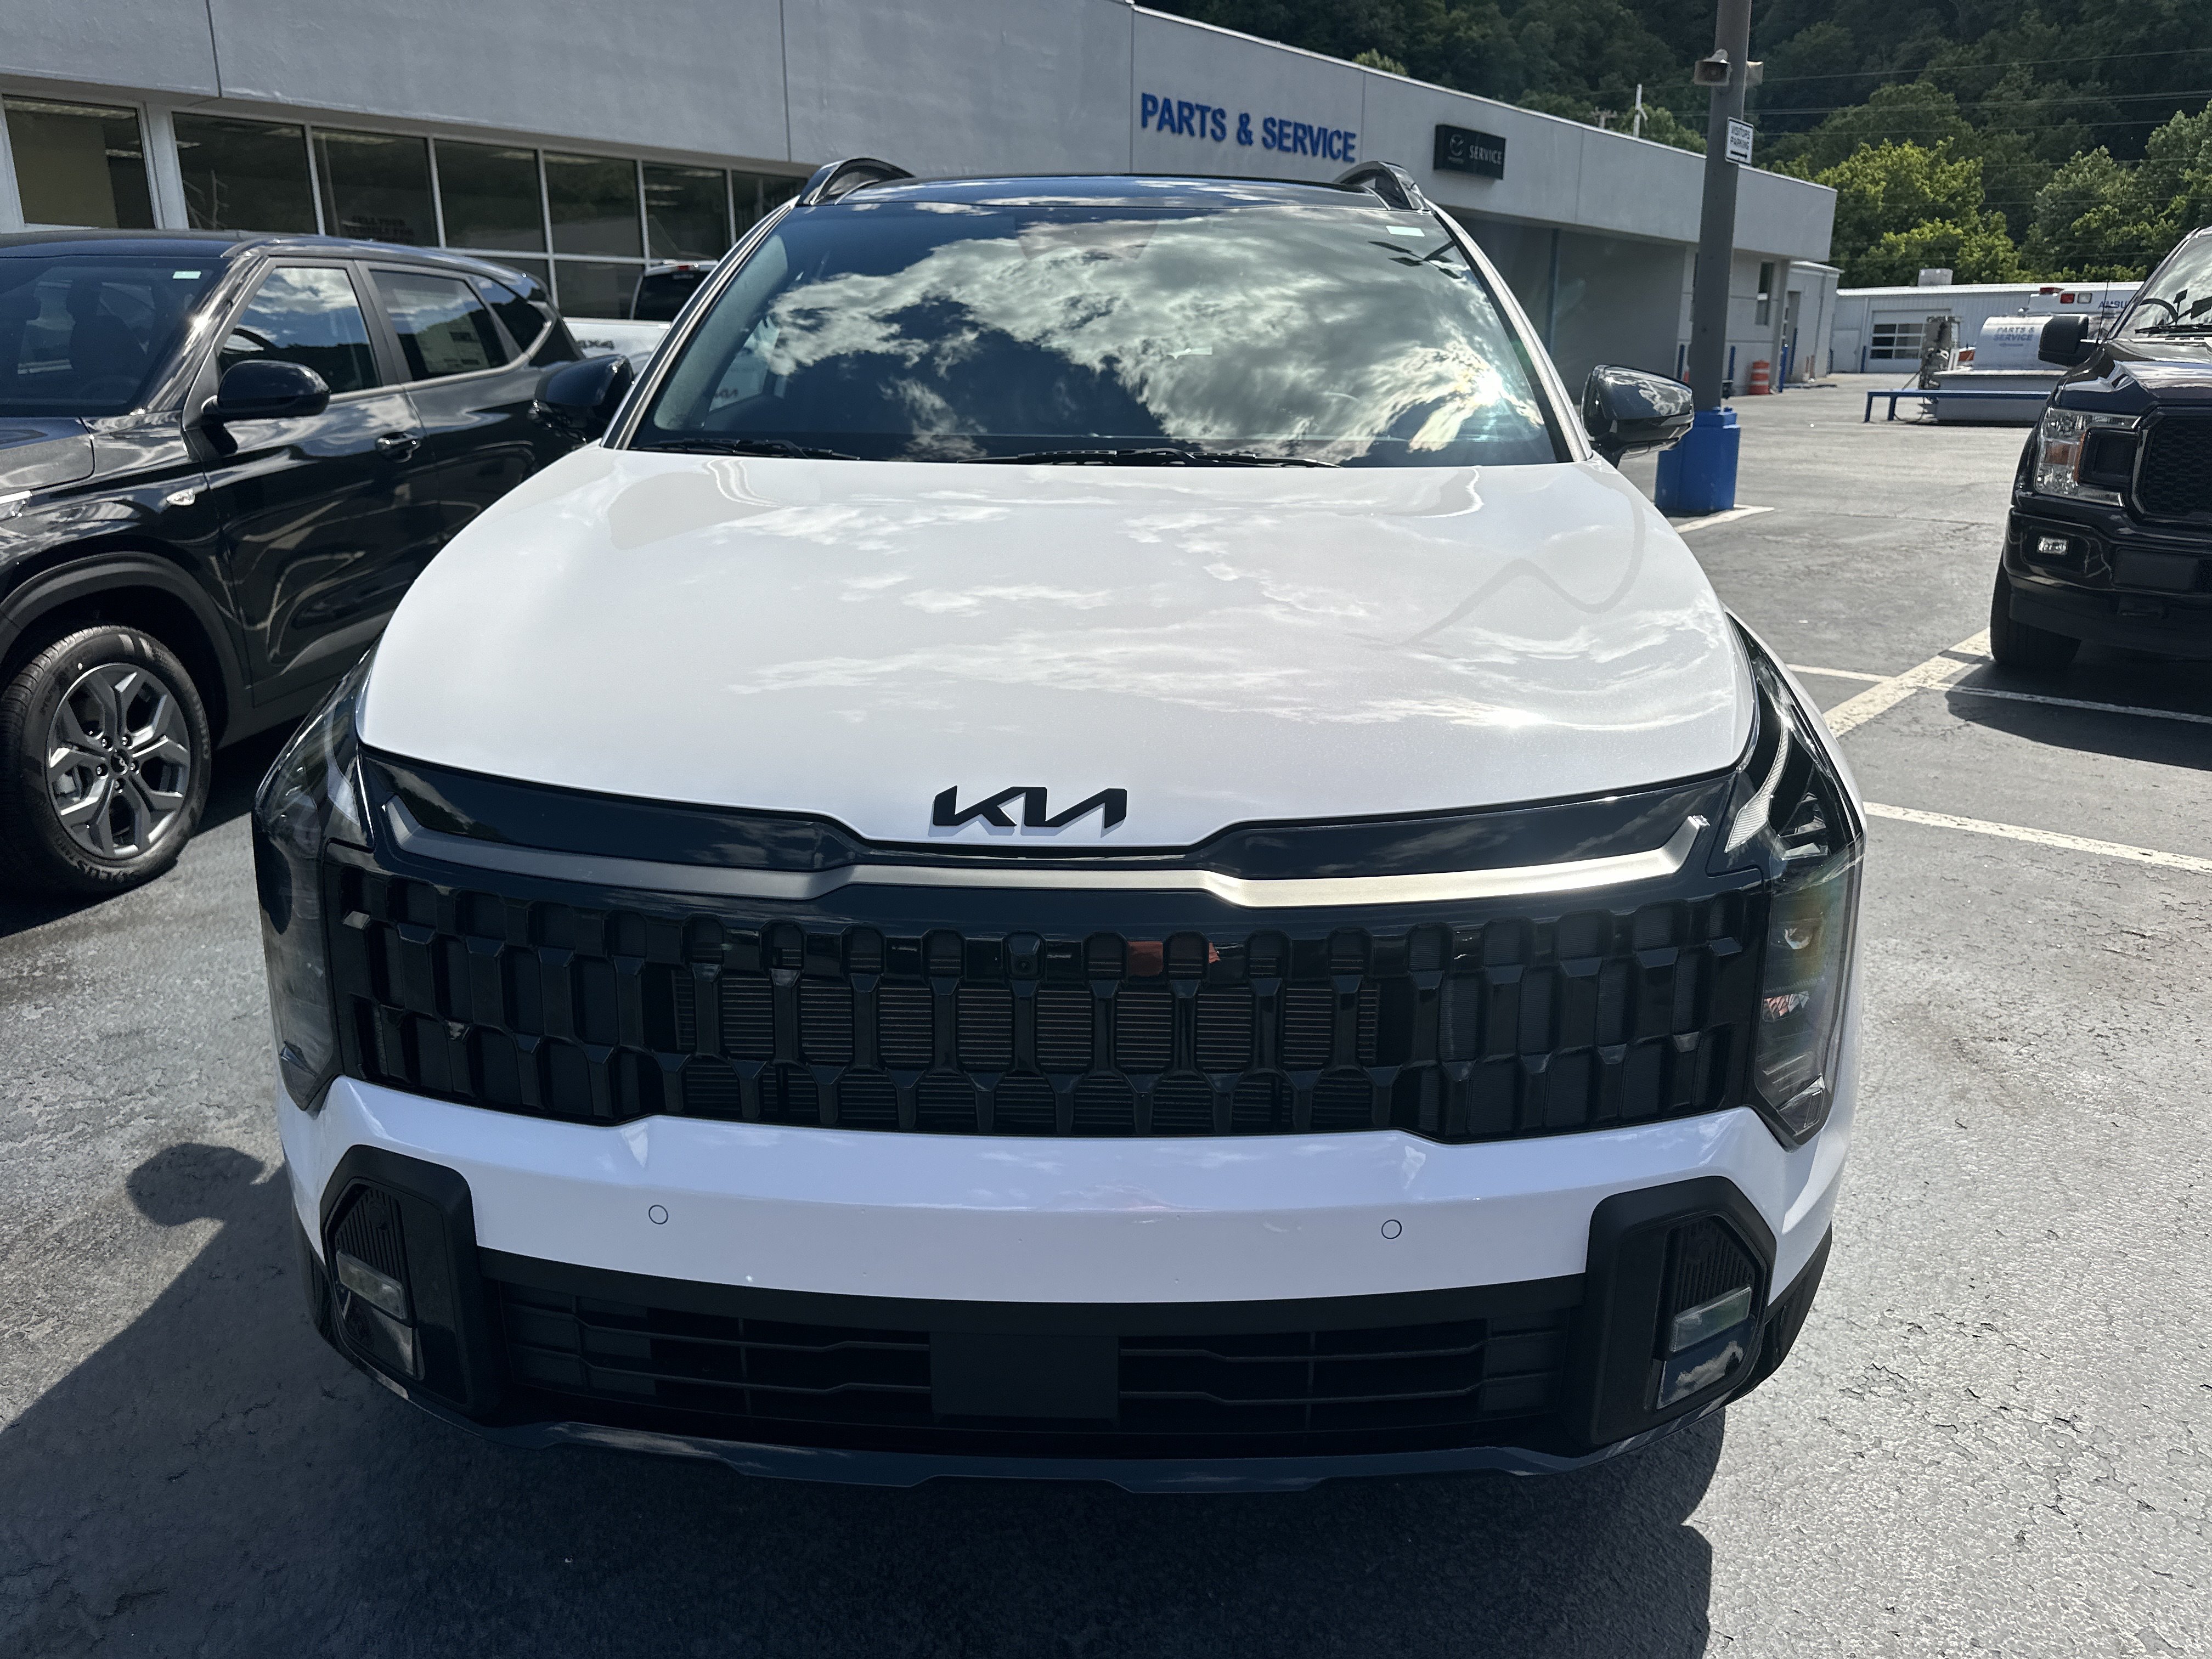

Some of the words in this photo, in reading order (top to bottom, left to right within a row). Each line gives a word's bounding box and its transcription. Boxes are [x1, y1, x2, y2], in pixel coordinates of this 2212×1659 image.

[1142, 93, 1227, 142] PARTS
[1237, 112, 1253, 146] &
[1262, 117, 1356, 163] SERVICE
[1470, 144, 1502, 165] SERVICE
[933, 785, 1127, 829] KIA
